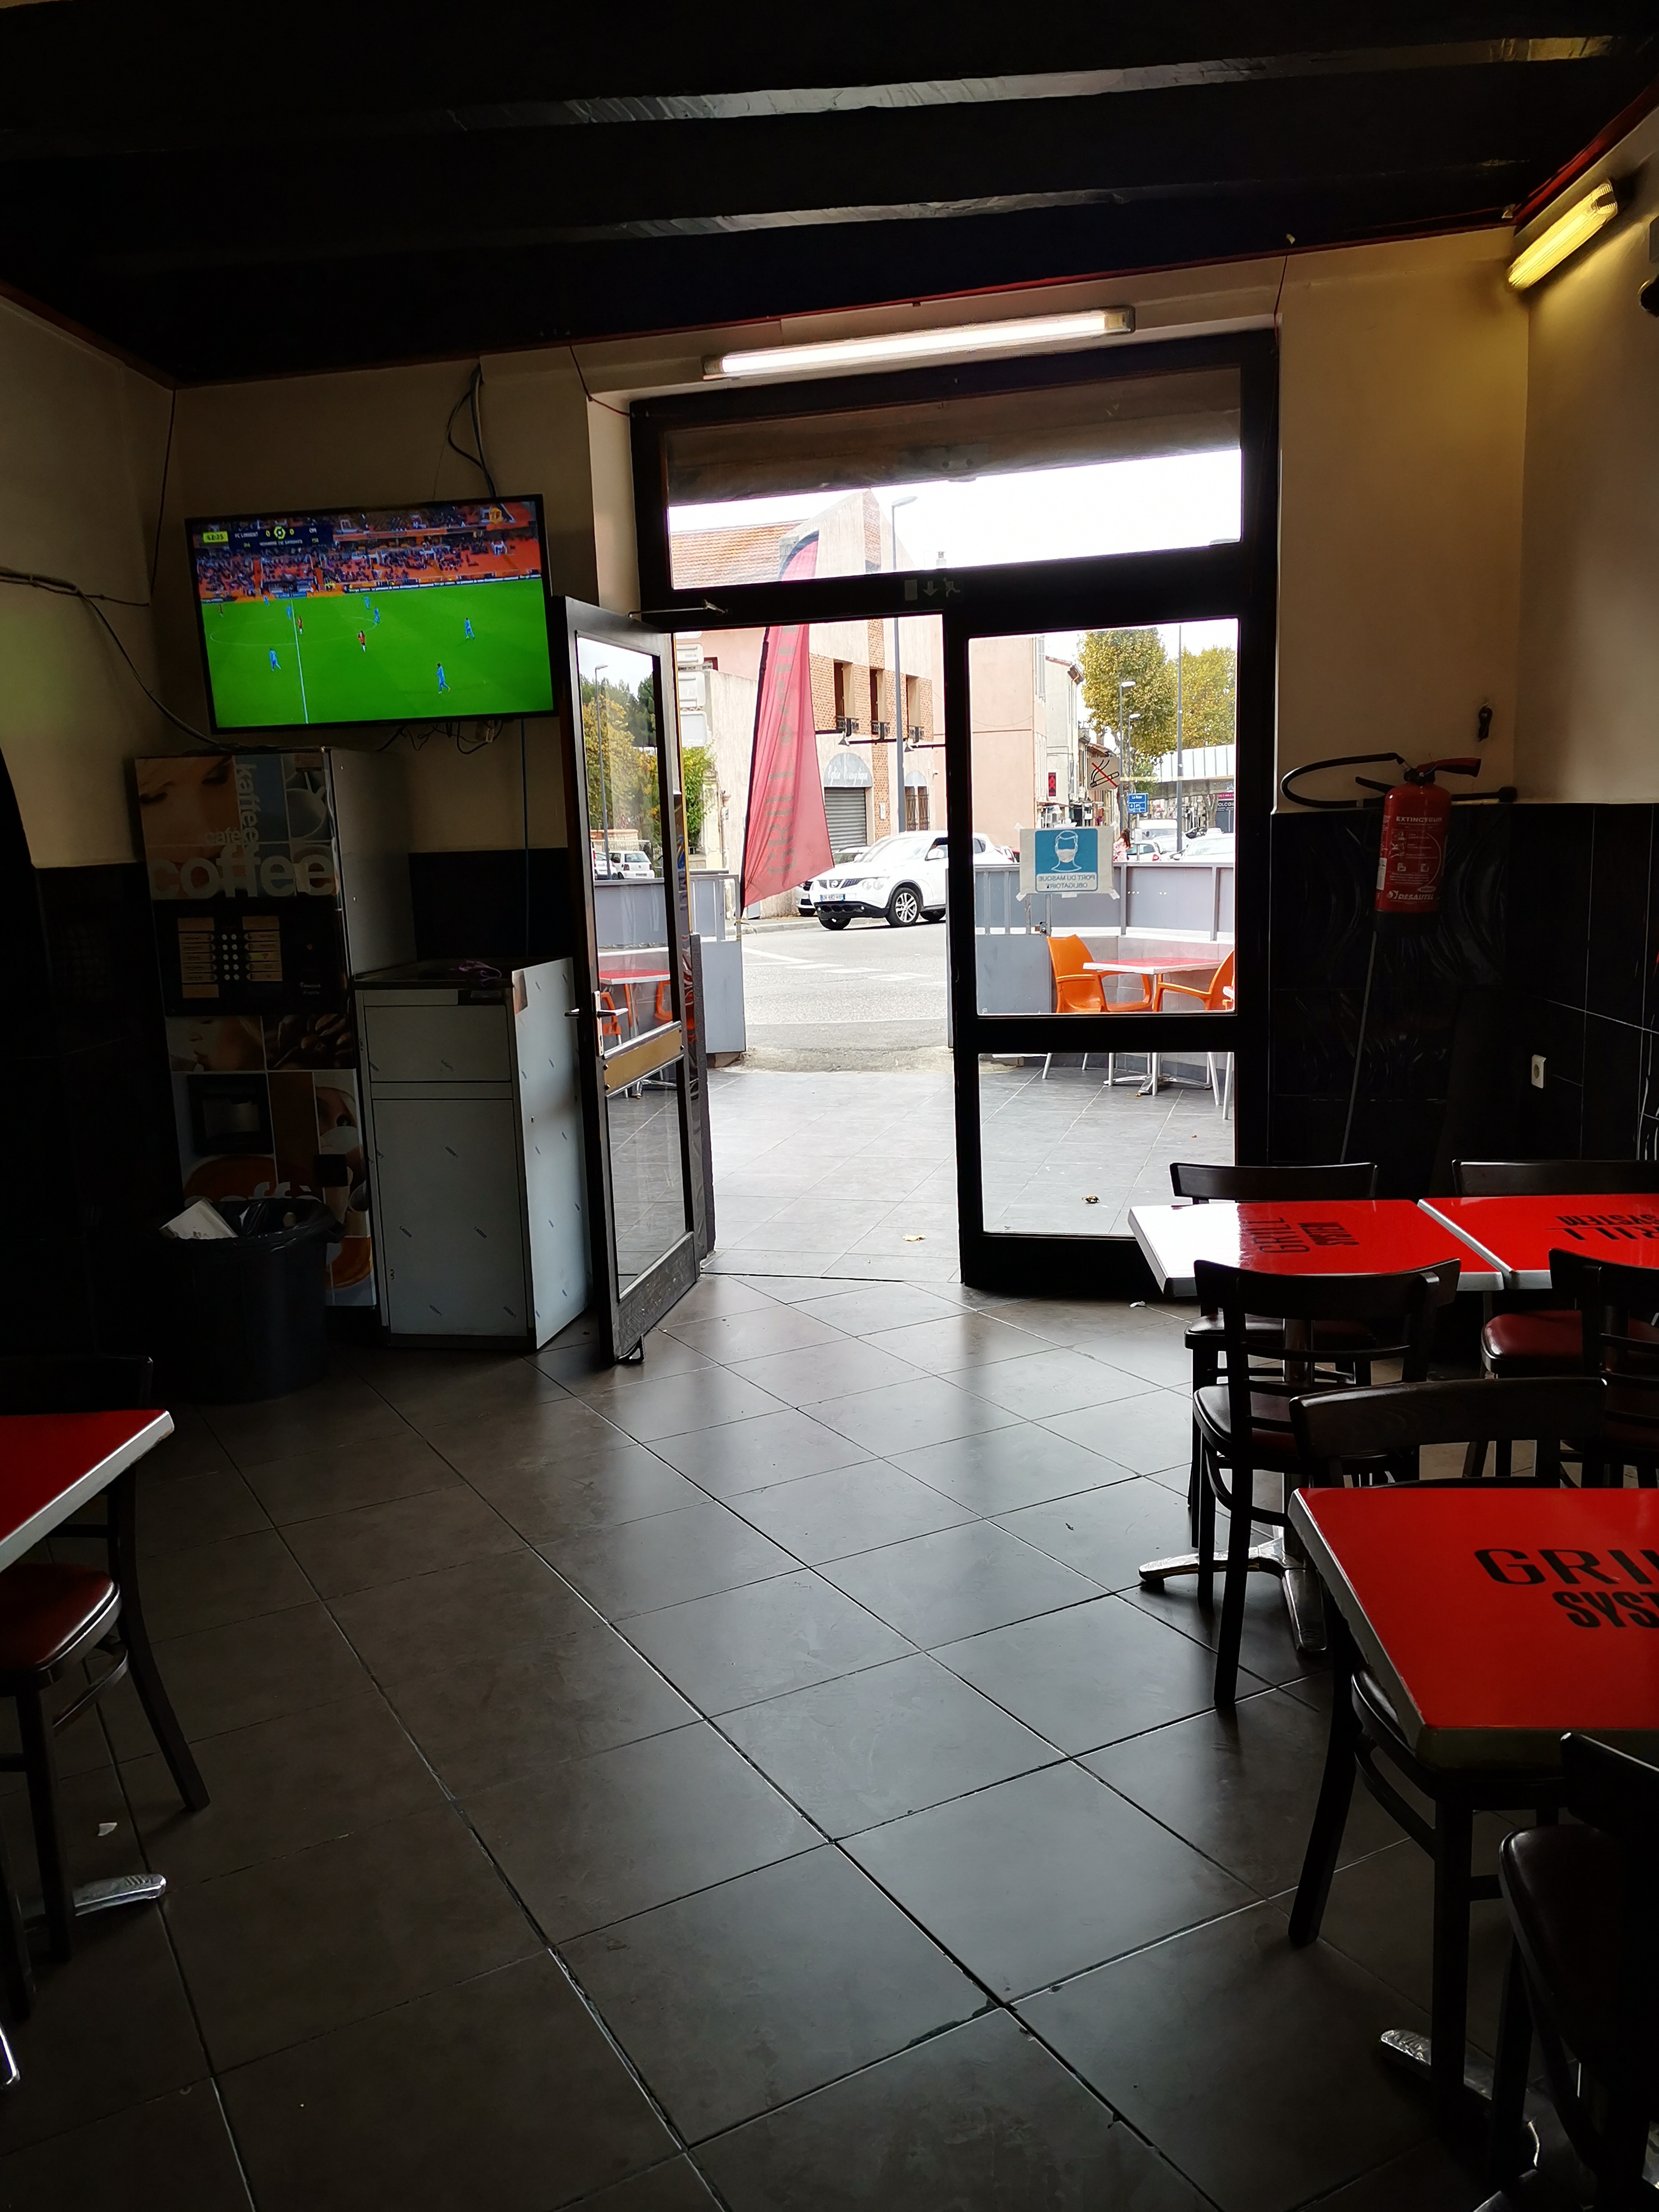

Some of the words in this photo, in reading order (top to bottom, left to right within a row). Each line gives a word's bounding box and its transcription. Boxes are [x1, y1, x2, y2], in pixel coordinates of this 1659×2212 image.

[235, 764, 260, 843] kaffee
[765, 759, 797, 875] GRILL
[149, 842, 336, 899] coffee
